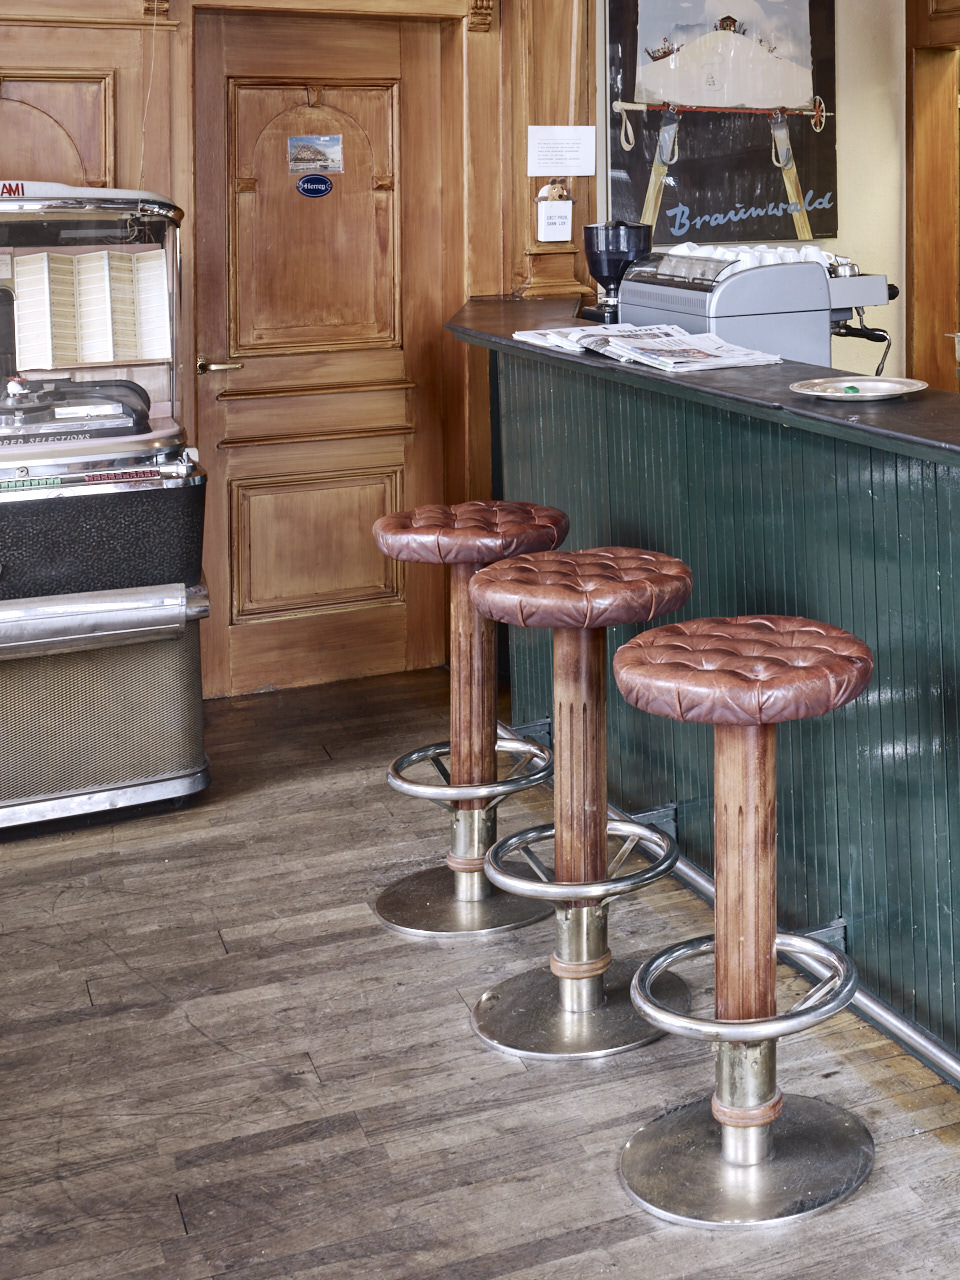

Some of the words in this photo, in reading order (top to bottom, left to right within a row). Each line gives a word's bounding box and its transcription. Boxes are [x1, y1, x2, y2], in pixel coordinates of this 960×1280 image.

[0, 183, 24, 196] AMI
[665, 190, 833, 237] Braunwald
[29, 433, 91, 445] SELECTIONS
